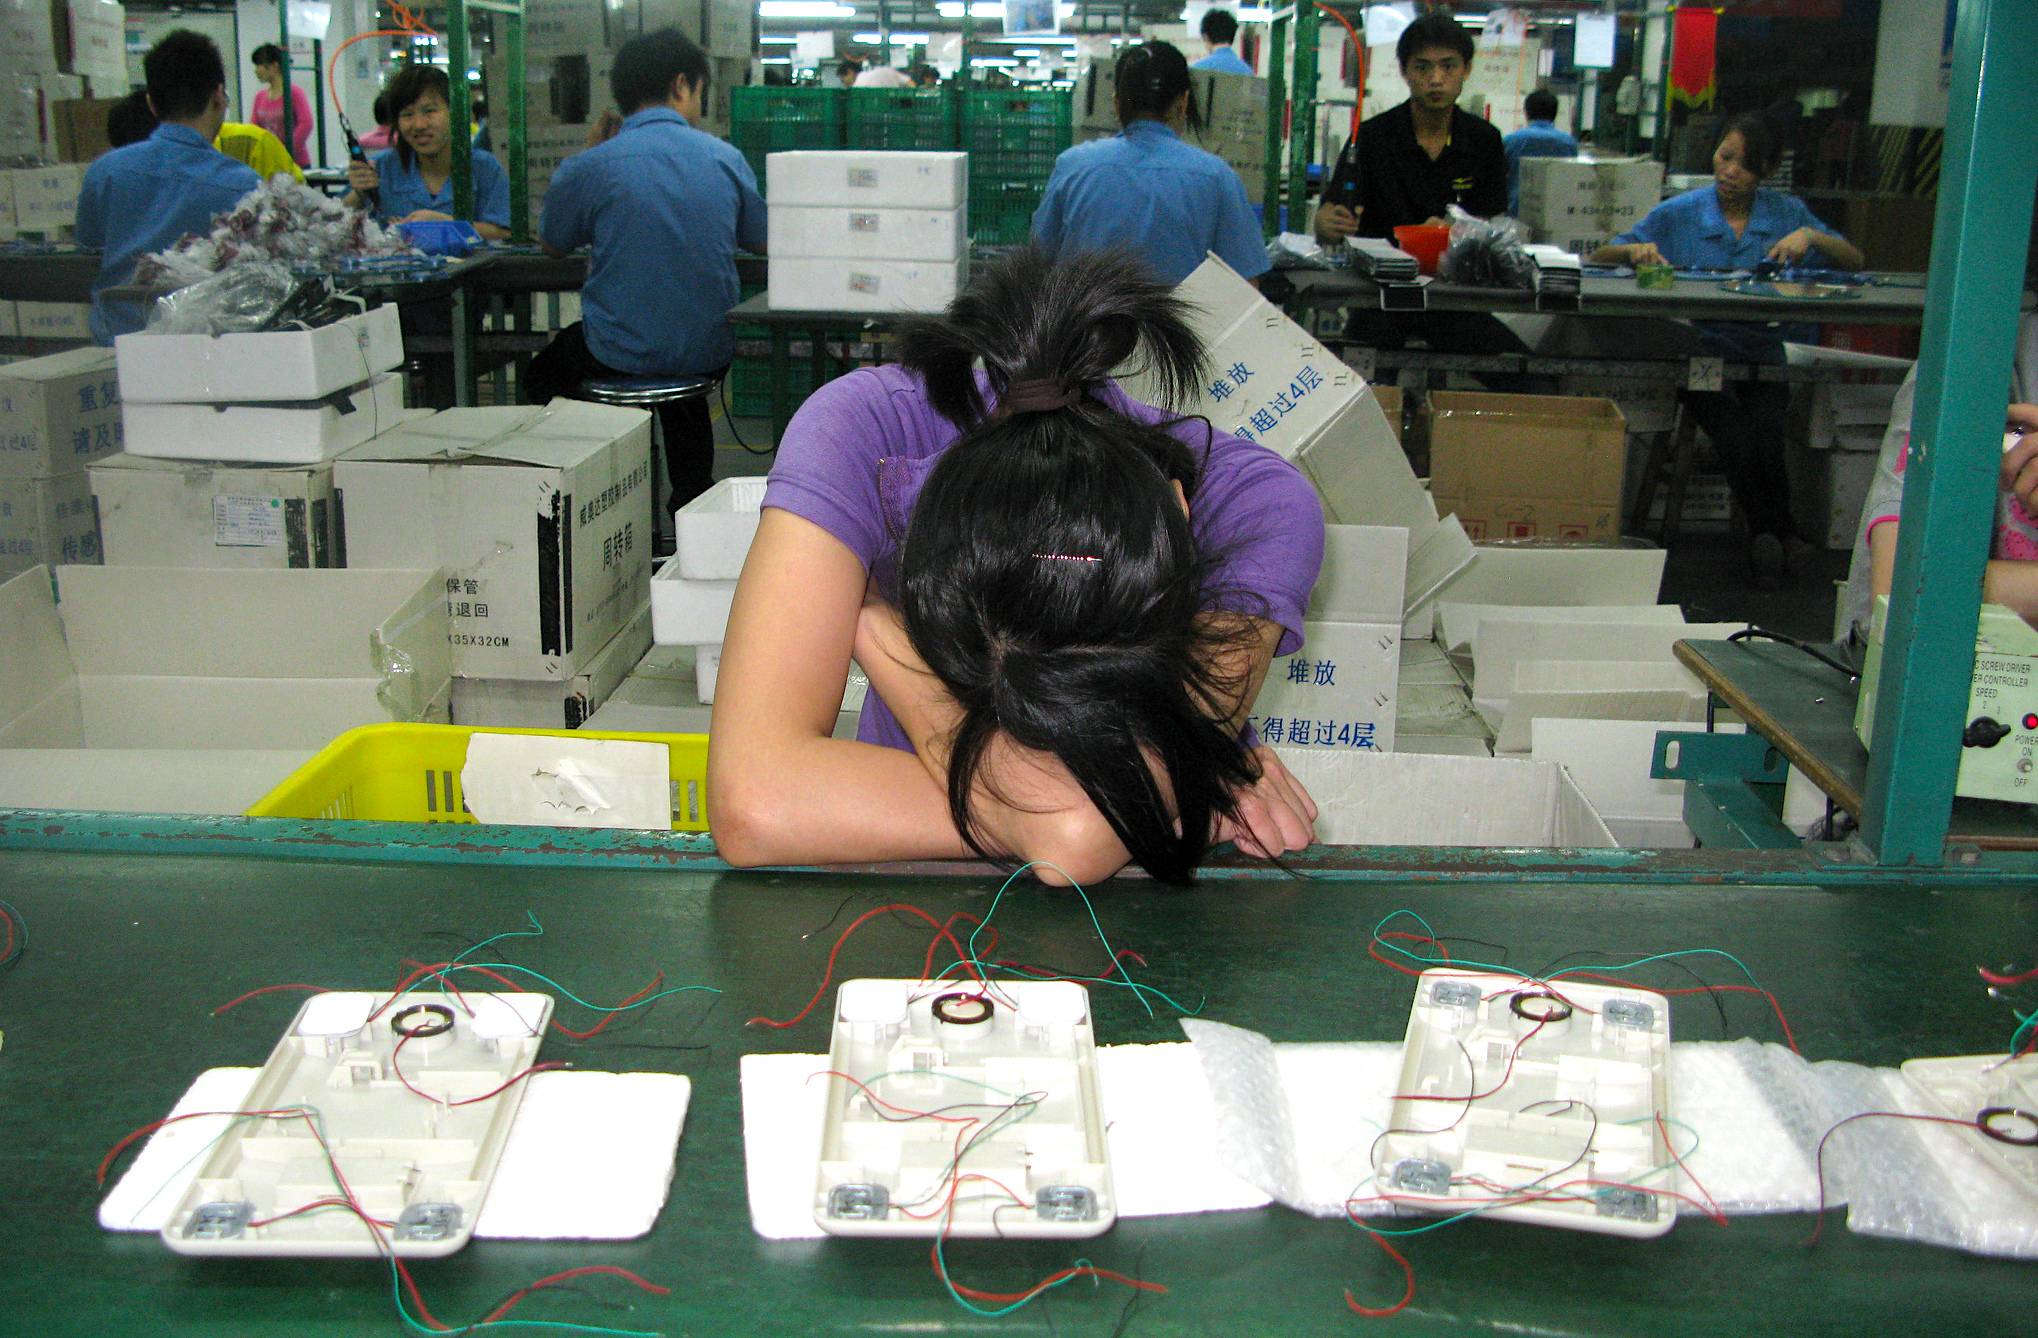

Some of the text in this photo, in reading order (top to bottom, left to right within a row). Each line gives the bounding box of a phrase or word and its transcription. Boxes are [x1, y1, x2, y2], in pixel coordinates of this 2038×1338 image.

[1208, 362, 1254, 402] 堆放
[603, 520, 633, 571] 周转箱
[446, 578, 479, 595] 保管
[1287, 658, 1337, 686] 堆放
[1981, 660, 2005, 672] SCREW
[2006, 662, 2031, 674] DRIVER
[1984, 674, 2029, 687] CONTROLLER
[1975, 687, 1998, 699] SPEED
[2015, 734, 2038, 746] POWER
[2022, 746, 2032, 757] ON
[2013, 777, 2028, 787] OFF
